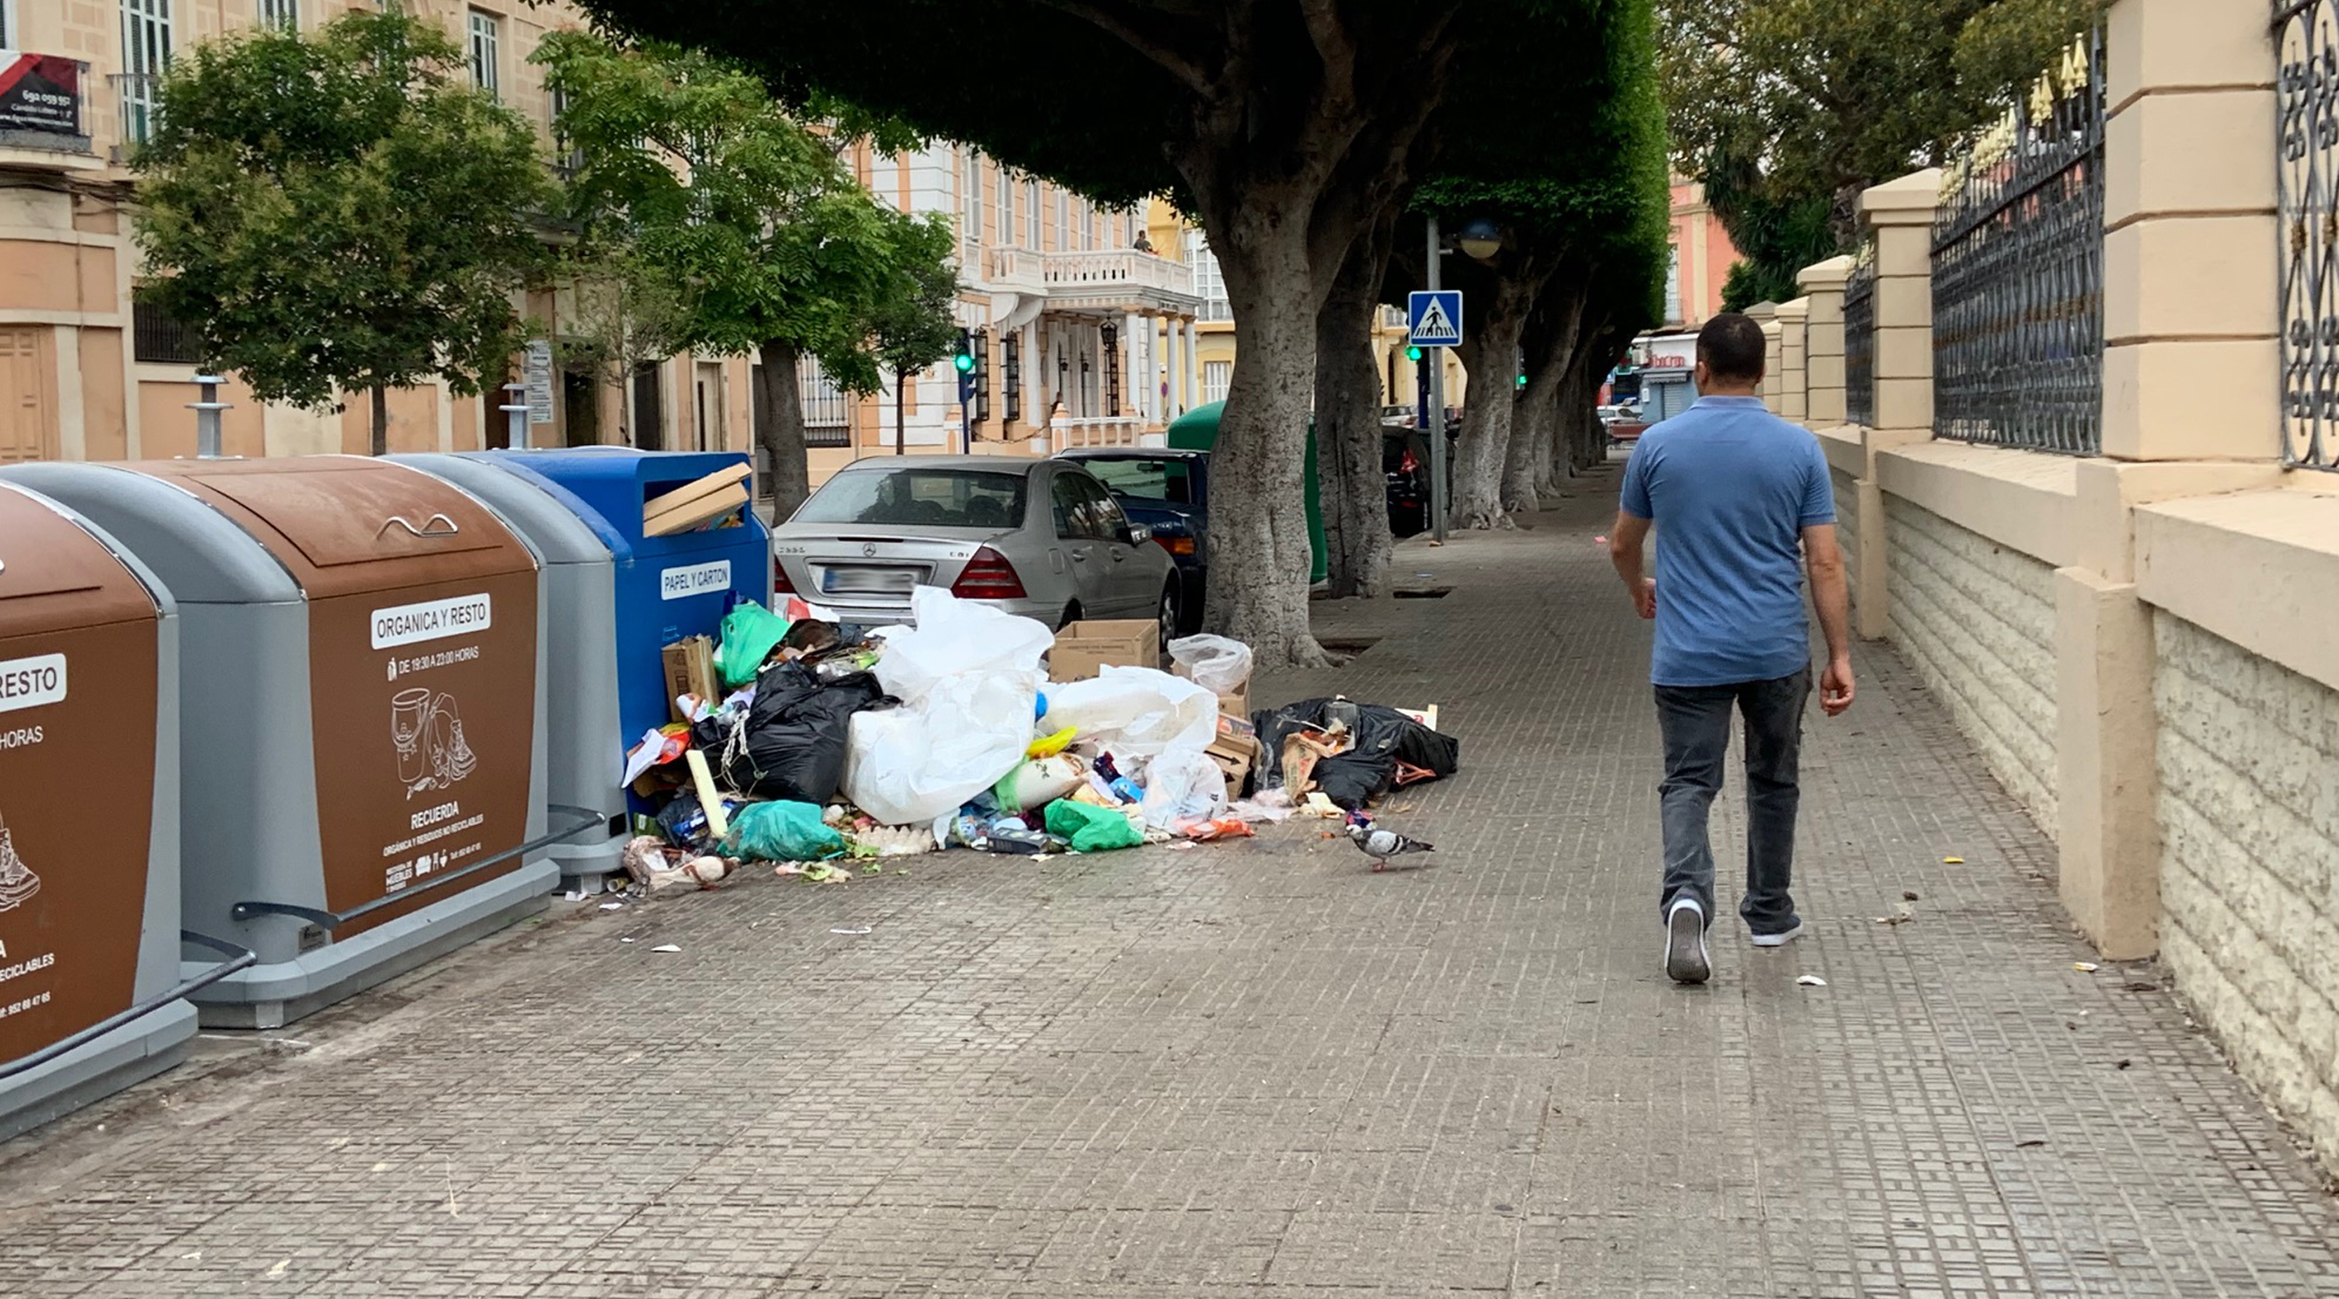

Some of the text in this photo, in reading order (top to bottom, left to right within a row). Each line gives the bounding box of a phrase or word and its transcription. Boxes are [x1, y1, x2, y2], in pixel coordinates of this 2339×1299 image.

[664, 567, 728, 592] PAPEL Y CARTON
[377, 603, 486, 638] ORGANICA Y RESTO
[399, 646, 479, 674] DE 19:30 A 23:00 HORAS
[0, 725, 44, 750] HORAS
[411, 800, 459, 830] RECUERDA
[412, 837, 417, 847] Y
[0, 952, 55, 982] ECICLABLES
